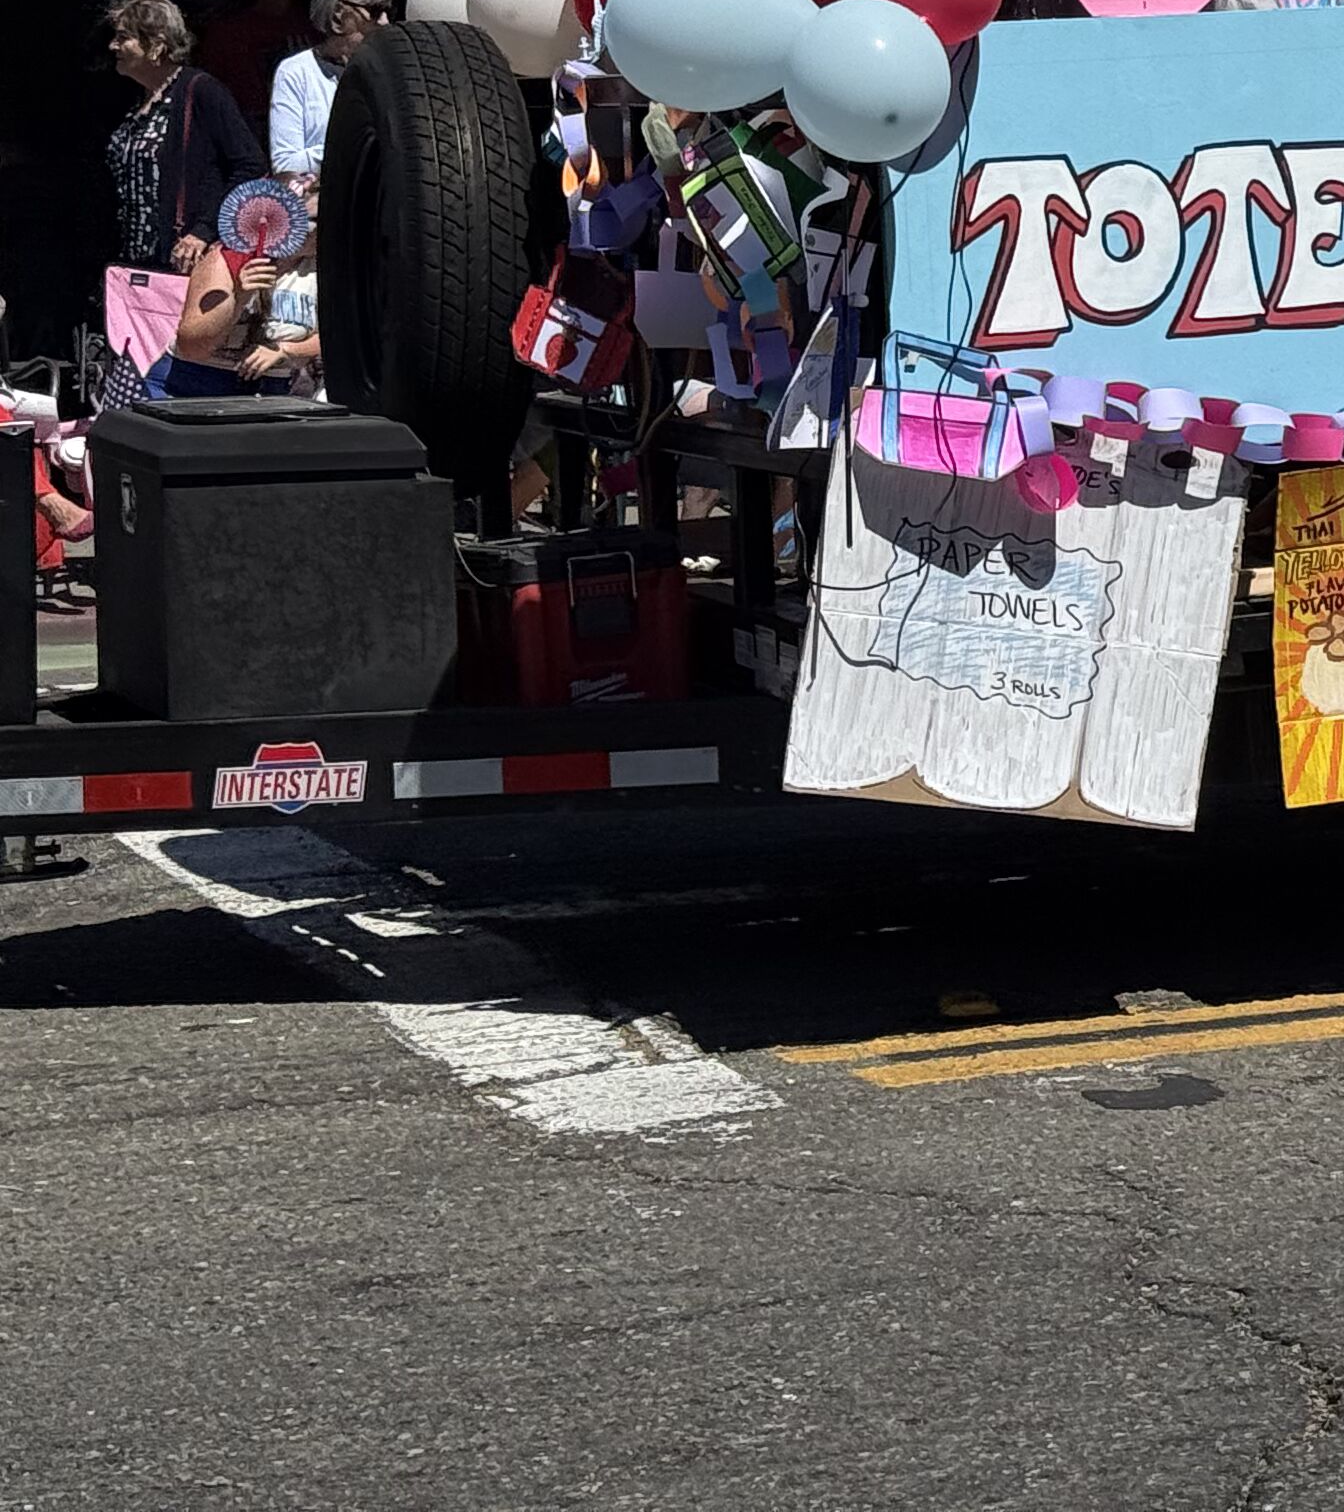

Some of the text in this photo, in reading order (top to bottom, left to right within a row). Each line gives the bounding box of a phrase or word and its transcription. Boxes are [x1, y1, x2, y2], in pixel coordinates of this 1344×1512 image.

[1293, 521, 1335, 542] THAI
[914, 537, 1040, 583] PAPER
[968, 590, 1084, 631] TOWELS
[990, 671, 1062, 700] 3 ROLLS
[219, 767, 361, 804] INTERSTATE
